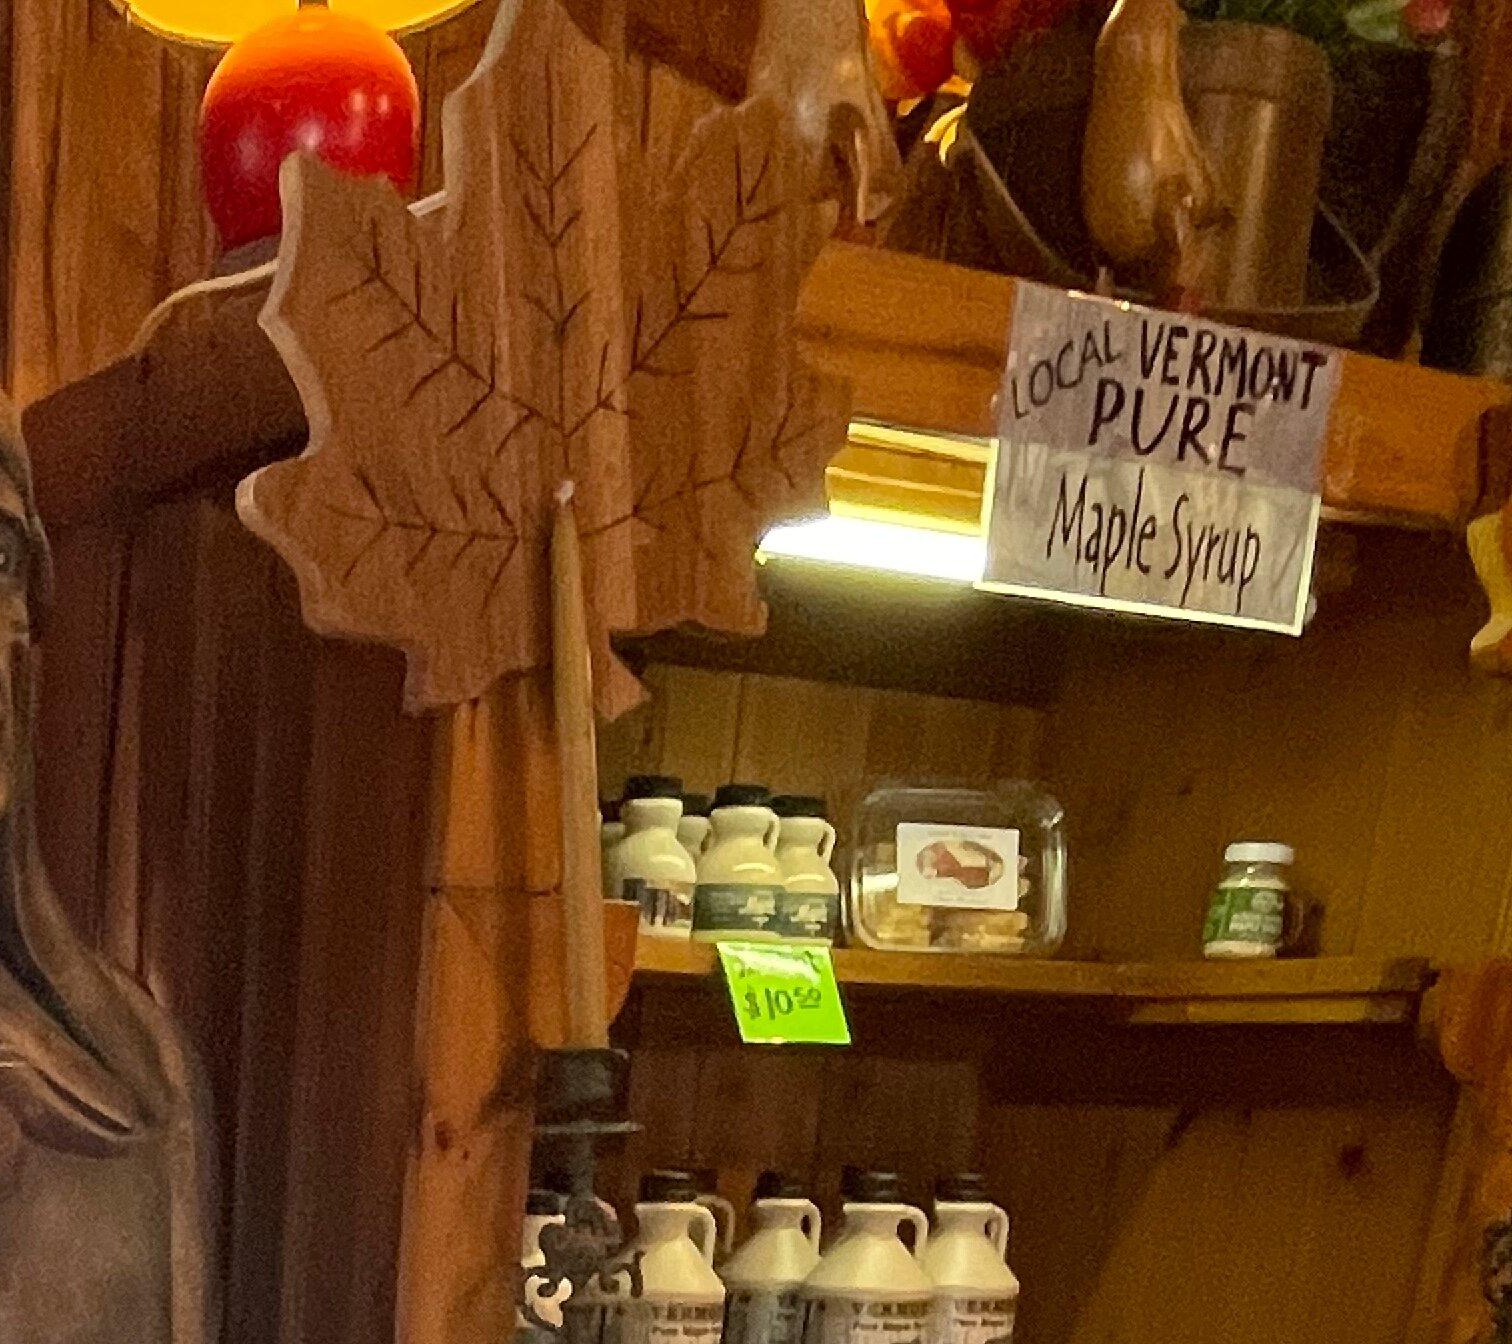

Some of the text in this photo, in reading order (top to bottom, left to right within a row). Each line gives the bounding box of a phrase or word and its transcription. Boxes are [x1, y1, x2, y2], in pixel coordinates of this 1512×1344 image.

[1011, 320, 1328, 420] LOCAL VERMONT
[1088, 378, 1257, 477] PURE
[1046, 467, 1261, 614] Maple Syrup
